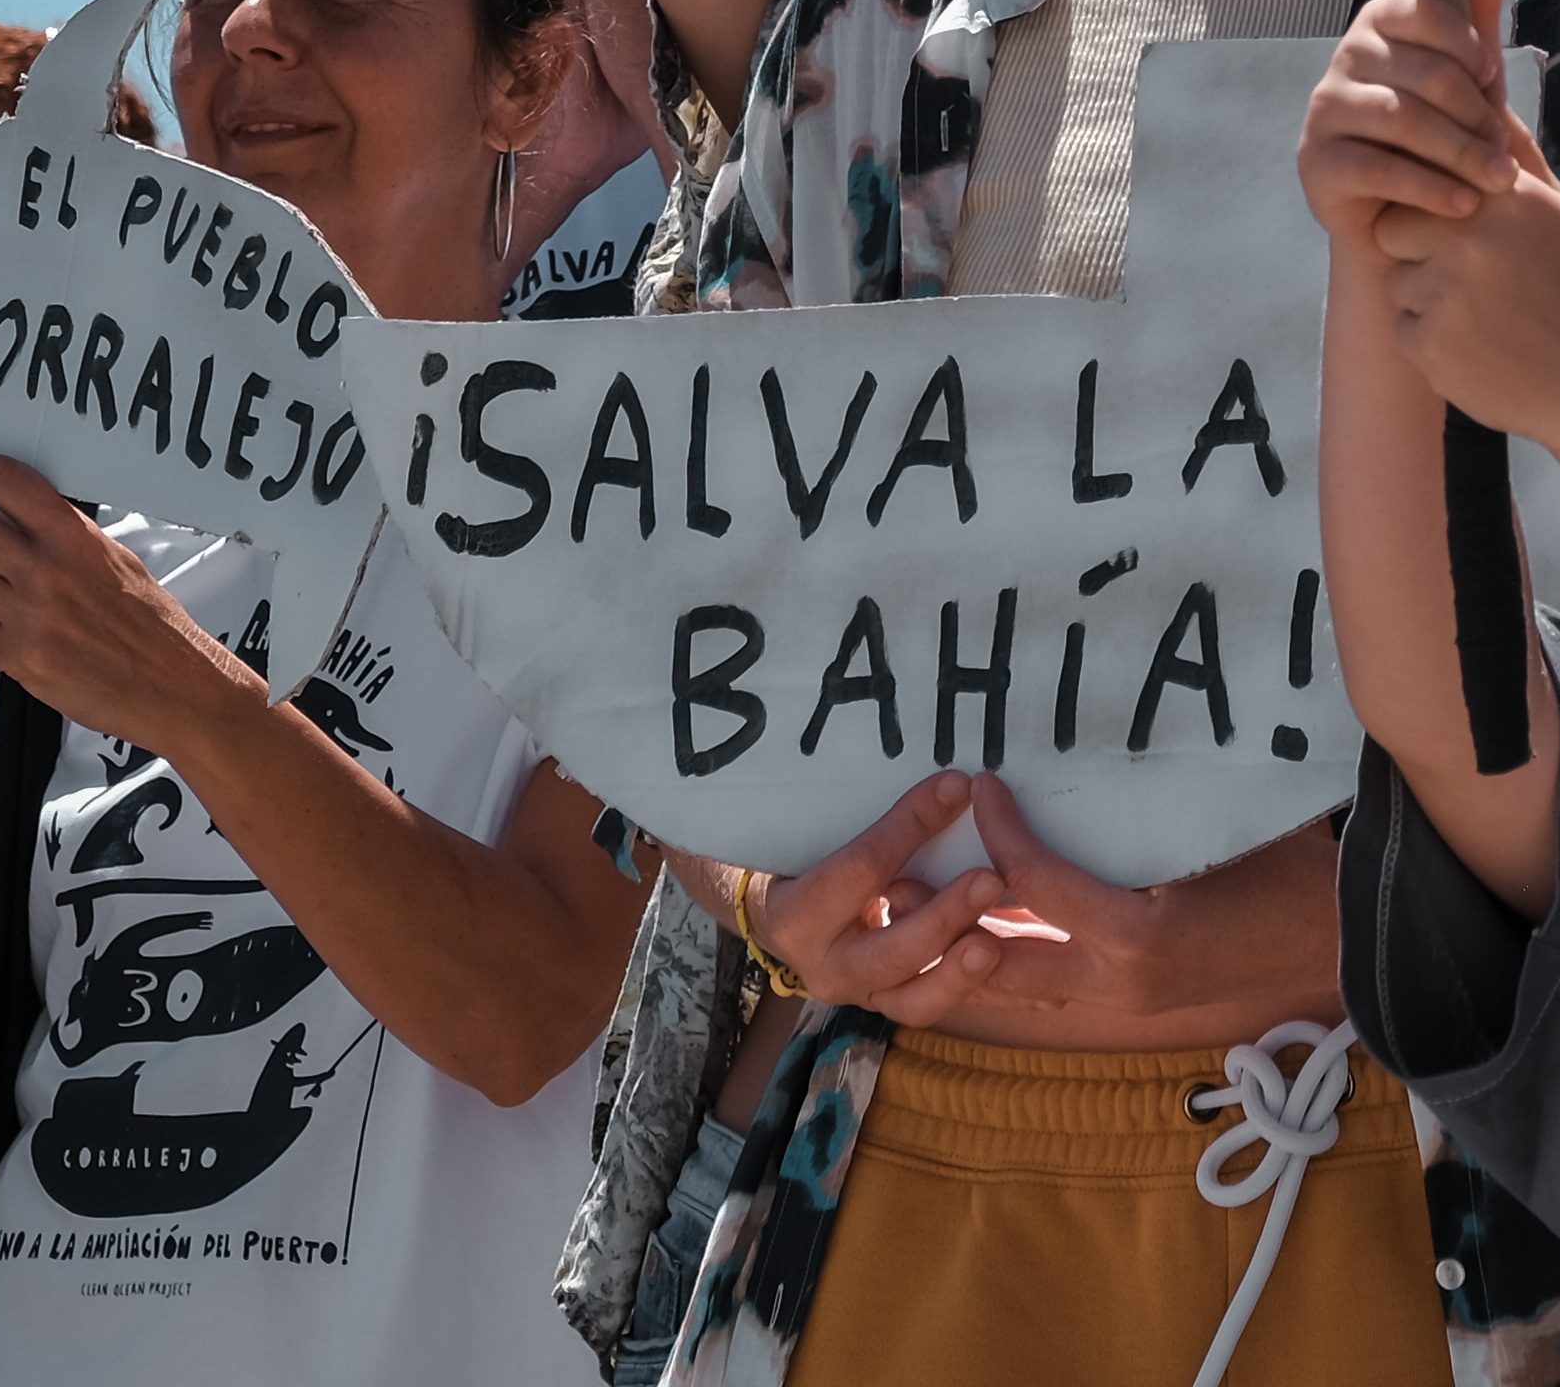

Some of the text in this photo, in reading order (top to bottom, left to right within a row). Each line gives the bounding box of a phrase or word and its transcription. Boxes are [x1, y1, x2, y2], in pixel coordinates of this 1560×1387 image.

[17, 145, 79, 232] EL
[118, 175, 348, 360] PUEBLO
[405, 352, 1288, 559] ¡SALVA LA
[322, 628, 395, 705] AHÍA
[671, 547, 1323, 778] BAHÍA!
[117, 968, 205, 1028] 30
[63, 1145, 218, 1172] CORRALEJO
[28, 1232, 44, 1260] A
[48, 1232, 77, 1261] LA
[202, 1232, 232, 1259] DEL
[80, 1282, 108, 1297] CLEAN
[148, 1281, 193, 1300] PROJECT
